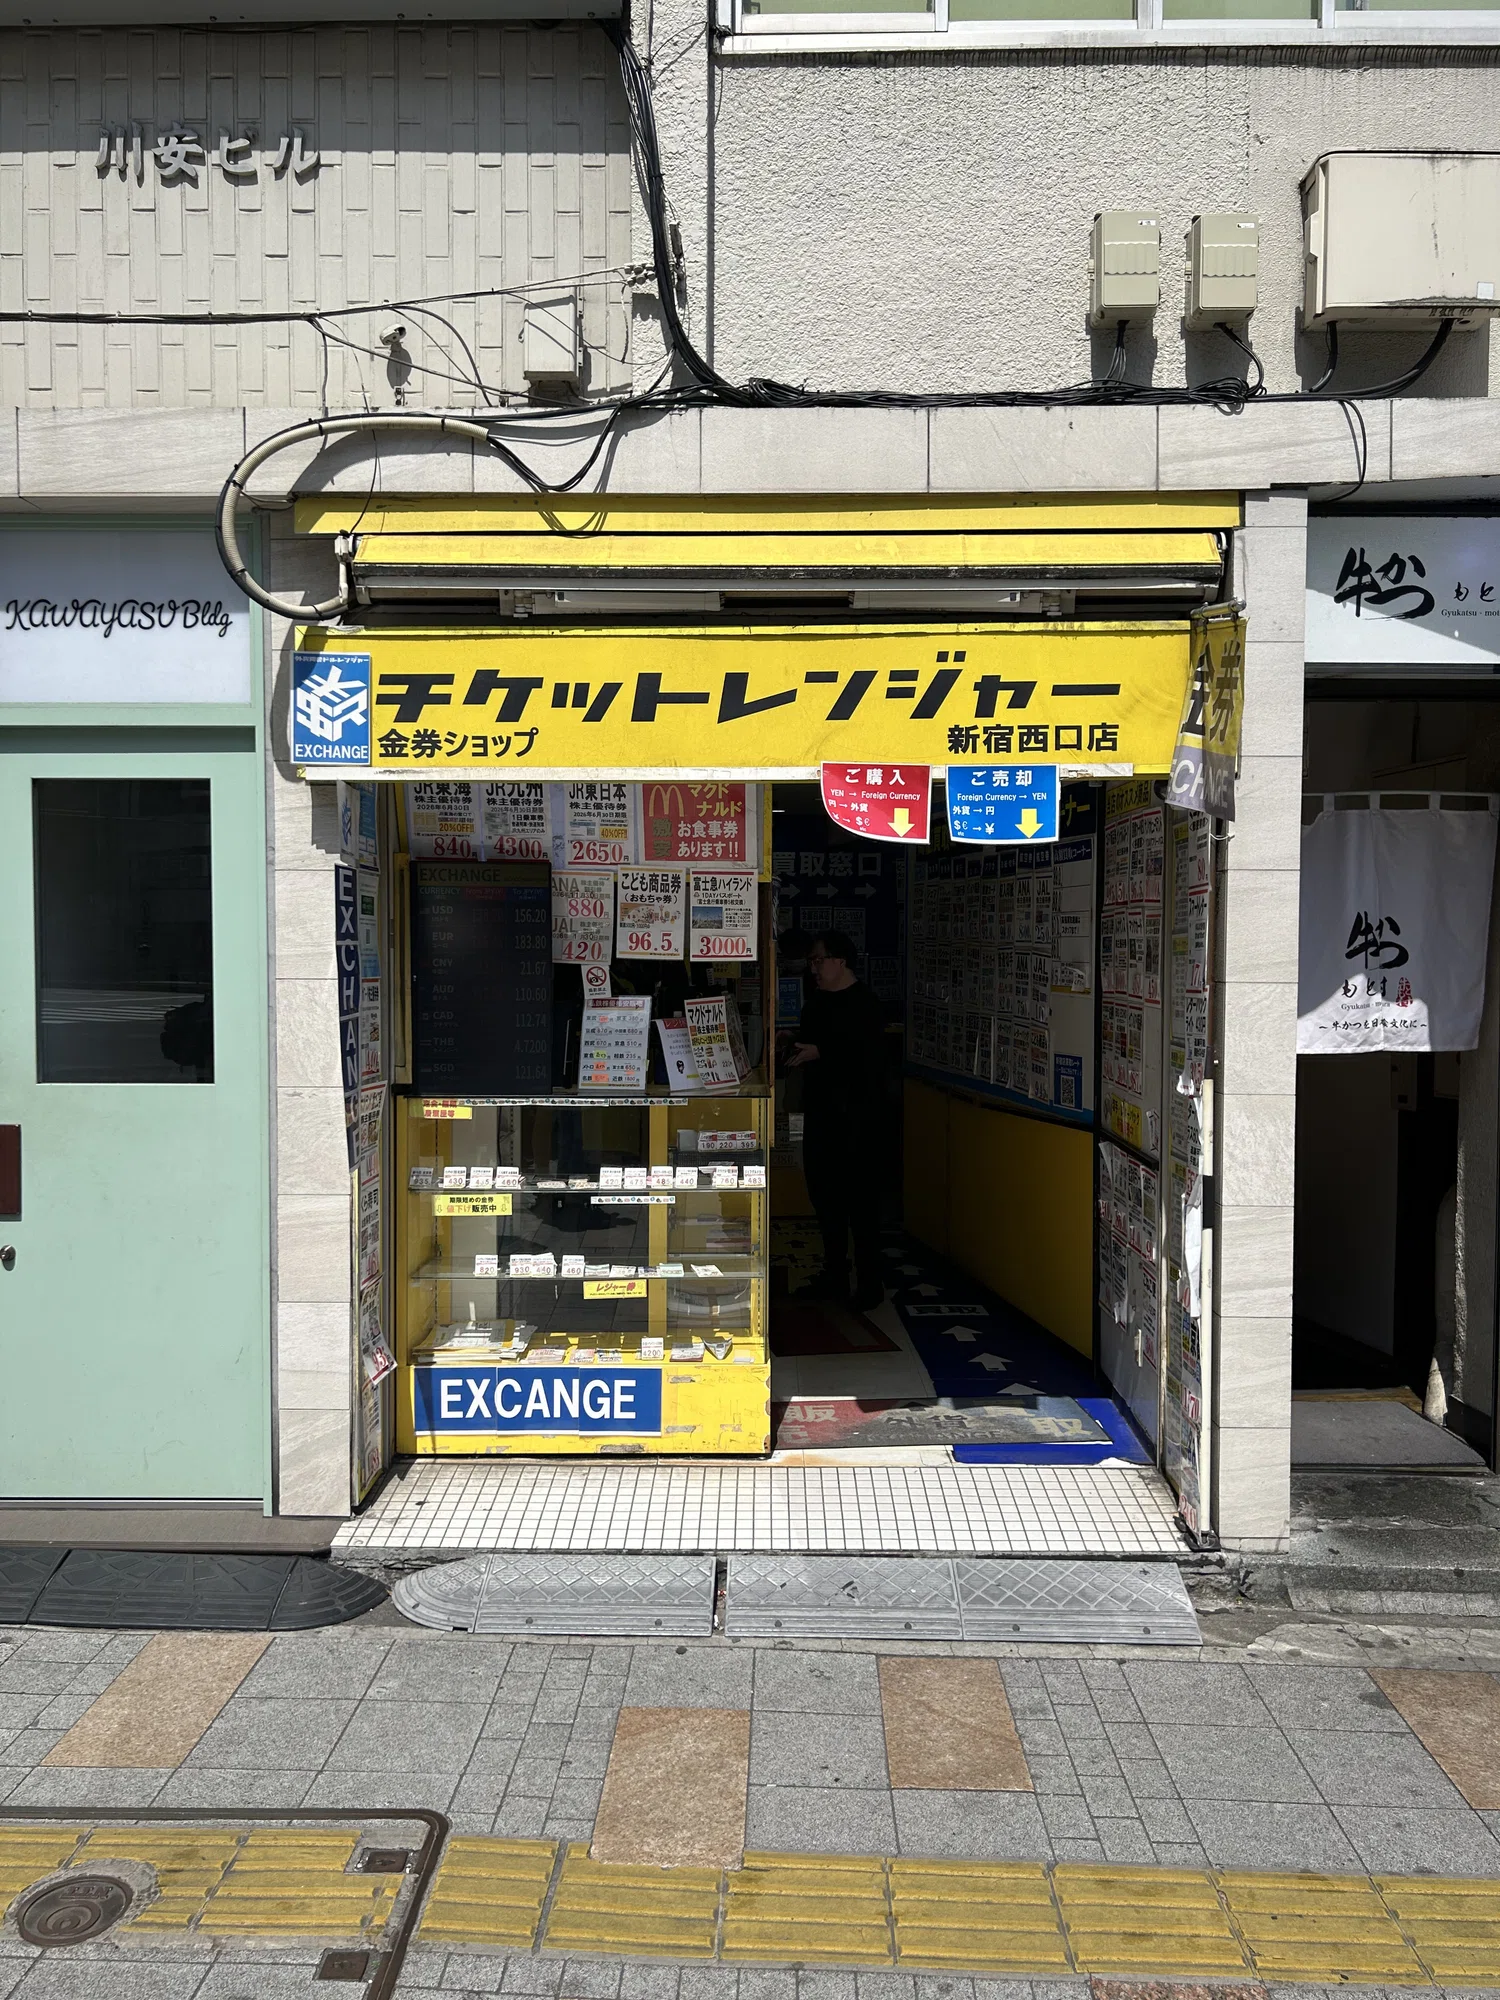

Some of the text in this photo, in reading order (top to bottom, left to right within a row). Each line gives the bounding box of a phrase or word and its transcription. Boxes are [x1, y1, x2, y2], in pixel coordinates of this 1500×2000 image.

[182, 599, 233, 638] Bldg
[1441, 608, 1477, 618] Gyukatsu
[375, 651, 1121, 725] チケットレンジャー
[377, 727, 539, 759] 金券ショップ
[947, 723, 1120, 754] 新宿西口店
[295, 744, 368, 759] EXCHANGE
[845, 768, 906, 786] ご購入
[971, 770, 1033, 787] ご売却
[414, 783, 471, 796] JR東海
[486, 783, 543, 798] JR九州
[569, 783, 627, 801] JR東日本
[687, 783, 730, 799] マクド
[830, 789, 921, 801] YEN Foreign Currency
[957, 792, 1047, 802] Foreign Currency YEN
[696, 801, 742, 817] ナルド
[828, 799, 868, 812] 円 外貨
[953, 806, 995, 815] 外貨 円
[677, 820, 739, 838] お食事券
[773, 852, 881, 877] 買取窓口
[419, 868, 501, 882] EXCHANGE
[621, 872, 681, 894] こども商品券
[693, 876, 753, 891] 富士急ハイランド
[419, 887, 461, 895] CURRENCY
[432, 905, 454, 914] USD
[514, 908, 547, 923] 156.20
[552, 918, 579, 933] JAL
[432, 932, 454, 940] EUR
[514, 935, 547, 949] 183.80
[519, 962, 547, 976] 21.67
[1034, 957, 1048, 975] JAL
[432, 1011, 455, 1020] CAD
[687, 1003, 724, 1025] マクドナルド
[361, 1188, 378, 1212] くら寿司
[447, 1204, 497, 1213] 値下げ販売中
[440, 1378, 636, 1420] EXCANGE
